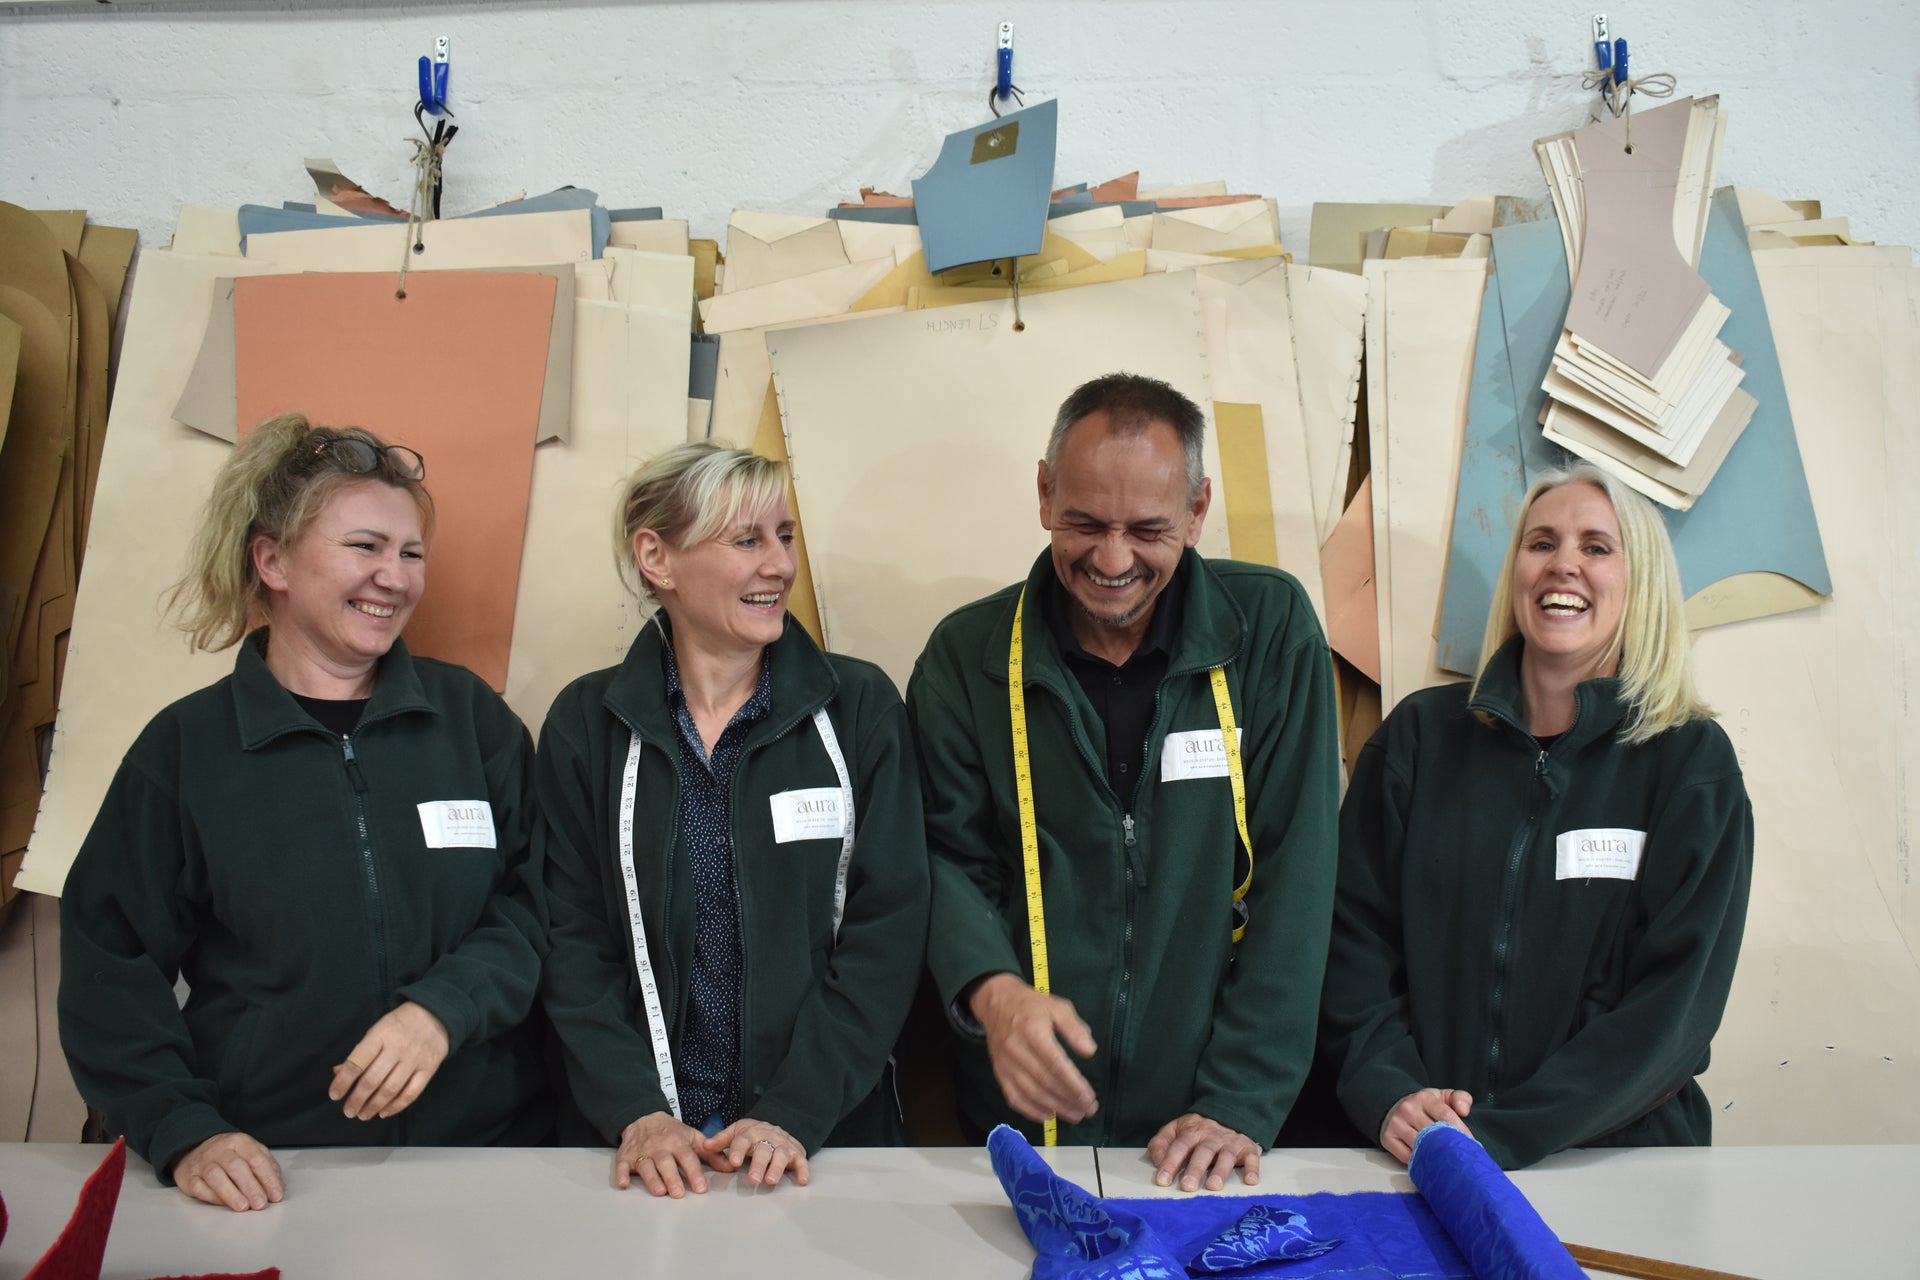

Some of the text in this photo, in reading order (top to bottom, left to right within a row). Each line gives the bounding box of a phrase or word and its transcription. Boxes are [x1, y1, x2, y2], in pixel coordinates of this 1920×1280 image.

[1222, 702, 1227, 710] 44
[1226, 725, 1232, 733] 45
[1017, 727, 1022, 735] 21
[1019, 750, 1024, 758] 20
[627, 776, 634, 787] 24
[625, 797, 632, 809] 23
[797, 799, 836, 814] aura
[1023, 797, 1028, 805] 18
[447, 807, 486, 821] aura
[624, 820, 630, 832] 22
[624, 843, 630, 855] 21
[1027, 844, 1032, 852] 16
[1581, 839, 1627, 853] aura
[626, 866, 633, 879] 20
[630, 890, 637, 902] 19
[634, 913, 640, 925] 18
[1034, 915, 1039, 923] 13
[637, 937, 645, 949] 17
[640, 960, 649, 972] 16
[646, 982, 654, 995] 15
[651, 1005, 660, 1018] 14
[656, 1028, 664, 1041] 13
[660, 1052, 669, 1064] 12
[664, 1075, 673, 1087] 11
[669, 1097, 678, 1109] 10
